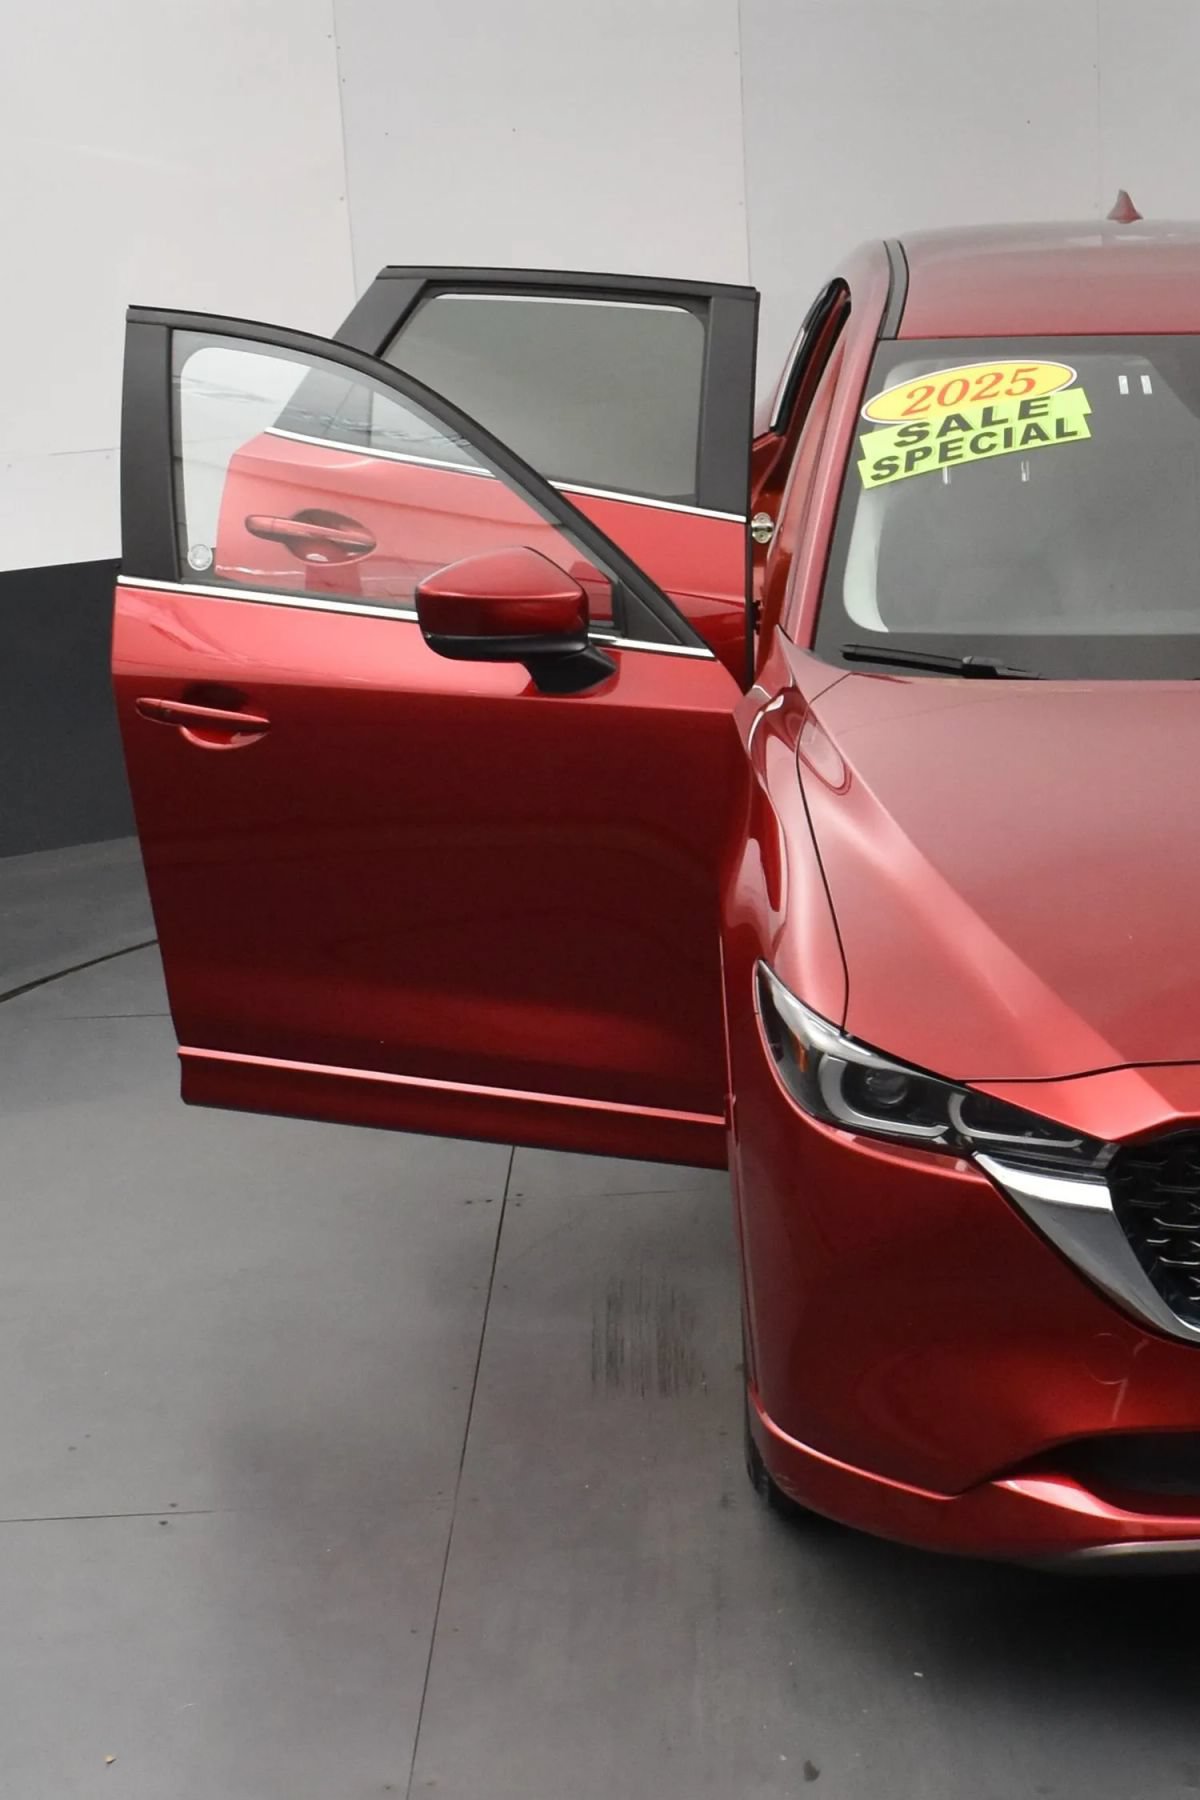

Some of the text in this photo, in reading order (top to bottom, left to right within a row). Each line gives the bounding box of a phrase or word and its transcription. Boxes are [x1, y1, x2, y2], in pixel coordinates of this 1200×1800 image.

[901, 367, 1039, 417] 2025
[894, 396, 1051, 447] SALE
[870, 417, 1078, 481] SPECIAL
